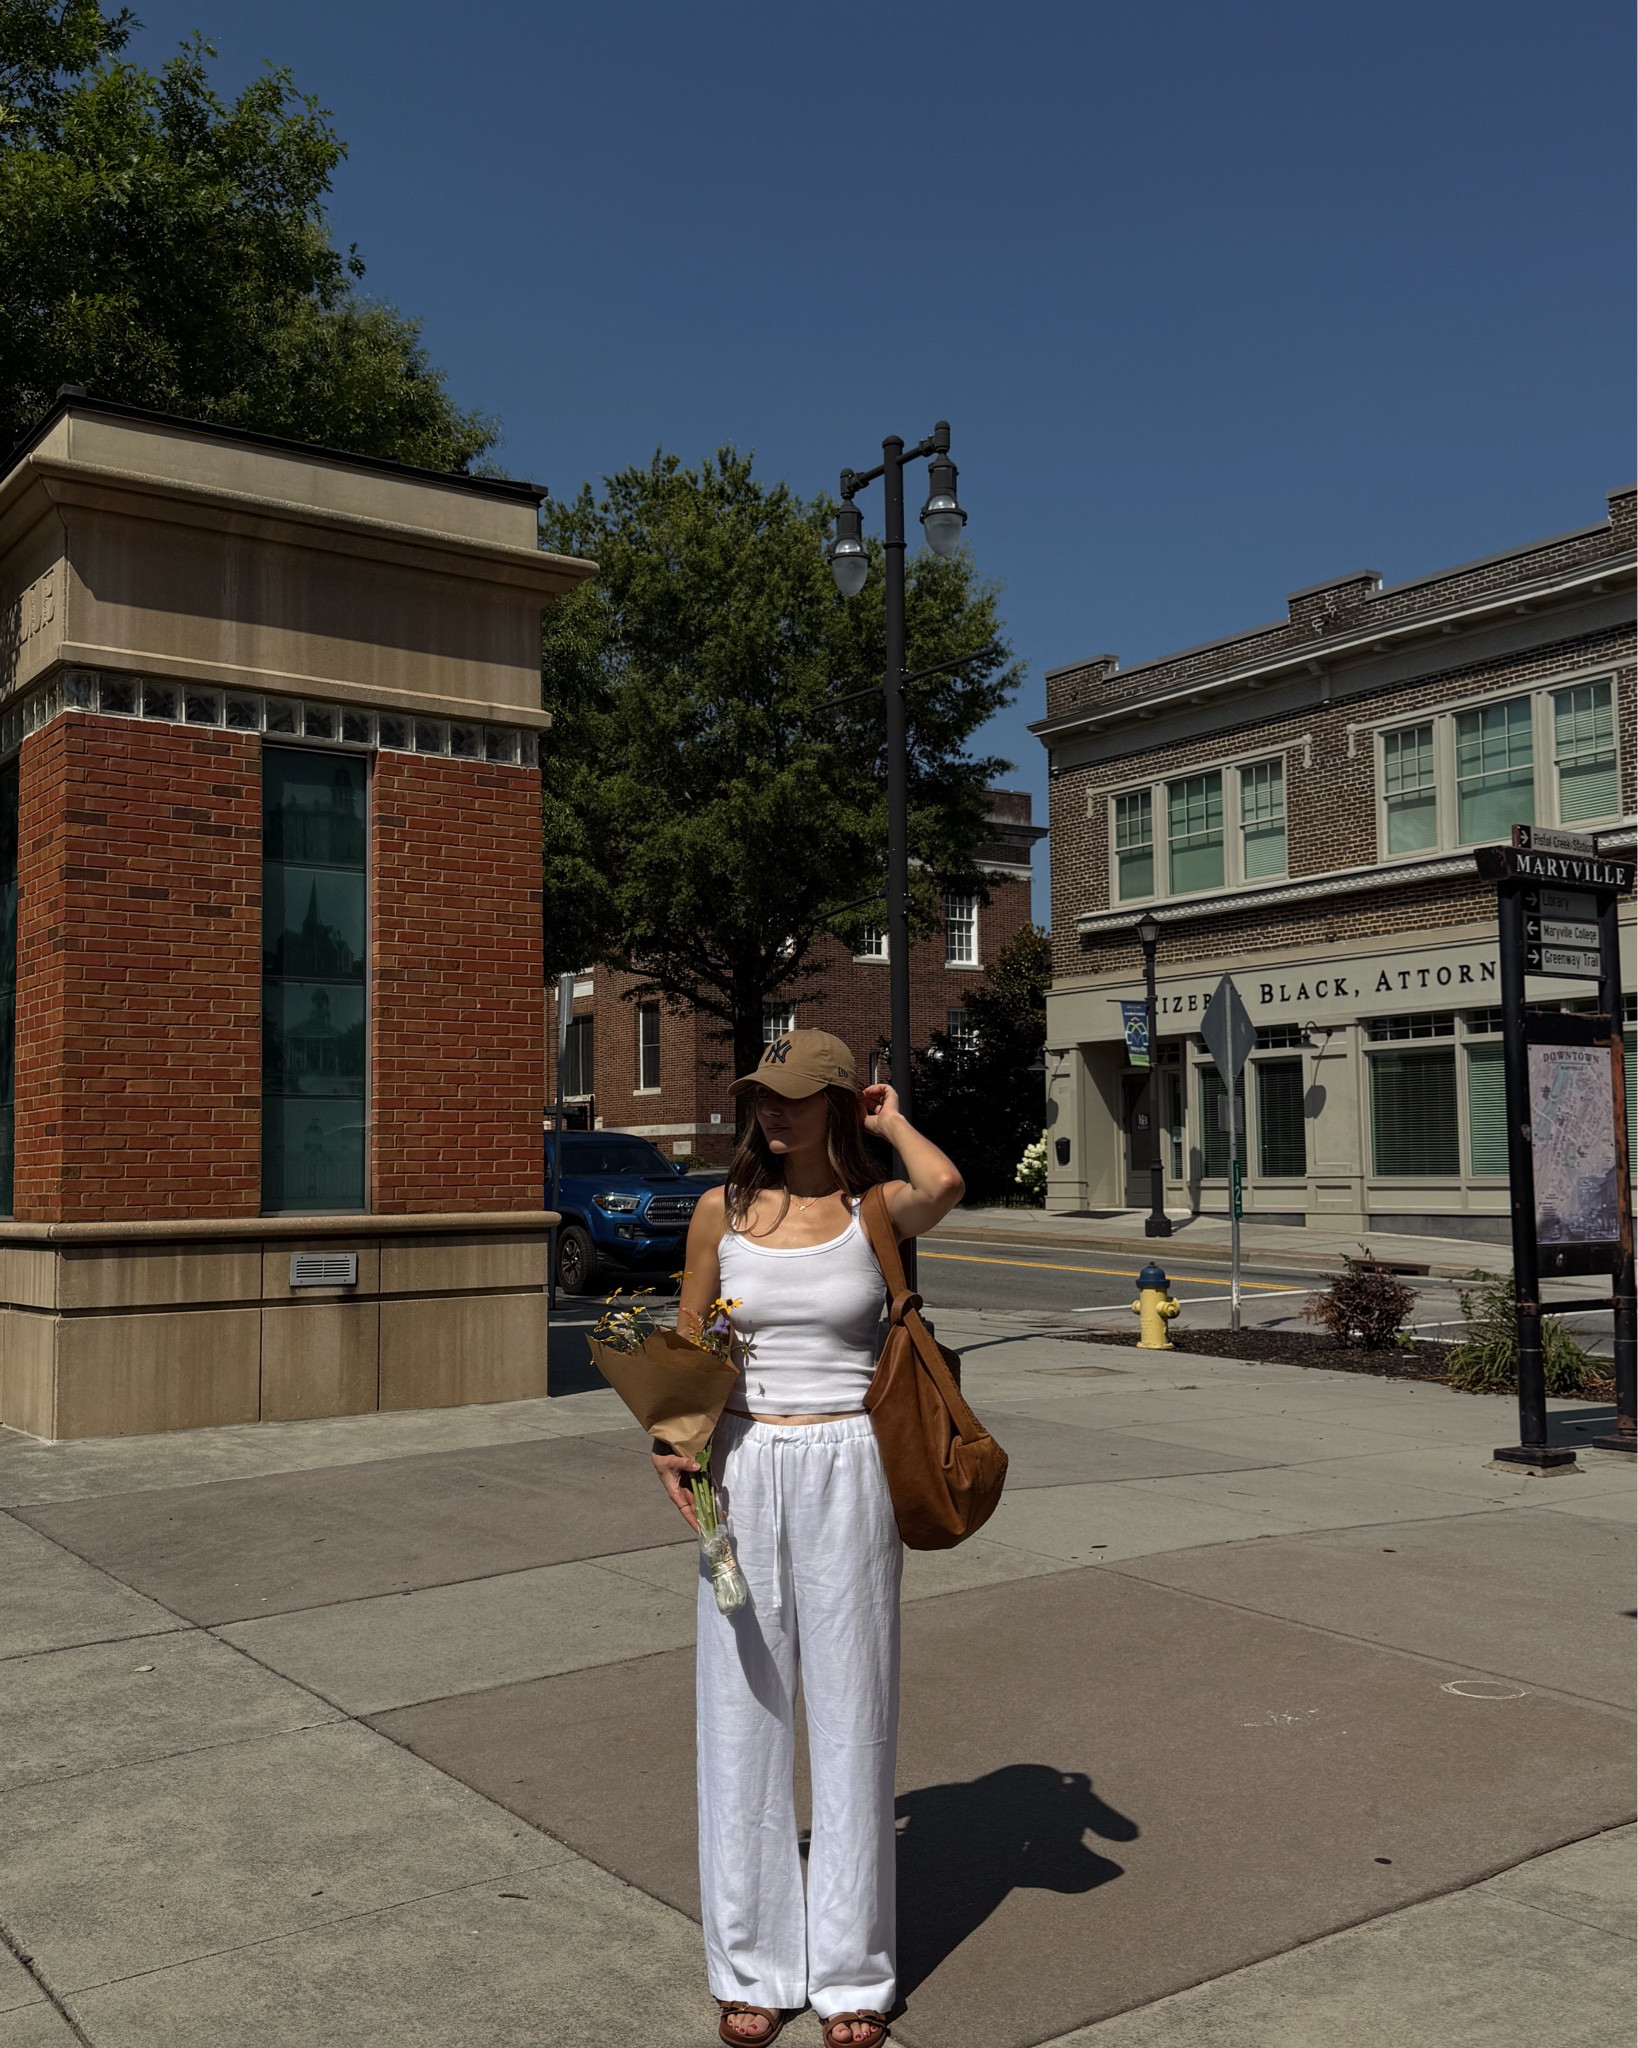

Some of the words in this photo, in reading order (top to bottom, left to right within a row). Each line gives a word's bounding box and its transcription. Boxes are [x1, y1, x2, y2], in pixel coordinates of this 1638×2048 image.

[1534, 833, 1552, 849] Pistol
[1553, 836, 1571, 851] Creek
[1572, 838, 1593, 853] Station
[1516, 854, 1626, 886] MARYVILLE
[1542, 893, 1569, 911] Library
[1543, 924, 1573, 940] Maryville
[1575, 927, 1597, 943] College
[1545, 950, 1581, 969] Greenway
[1583, 953, 1599, 967] Trail
[1260, 978, 1360, 1004] BLACK,
[765, 1039, 792, 1063] NY
[1543, 1051, 1600, 1065] DOWNTOWN
